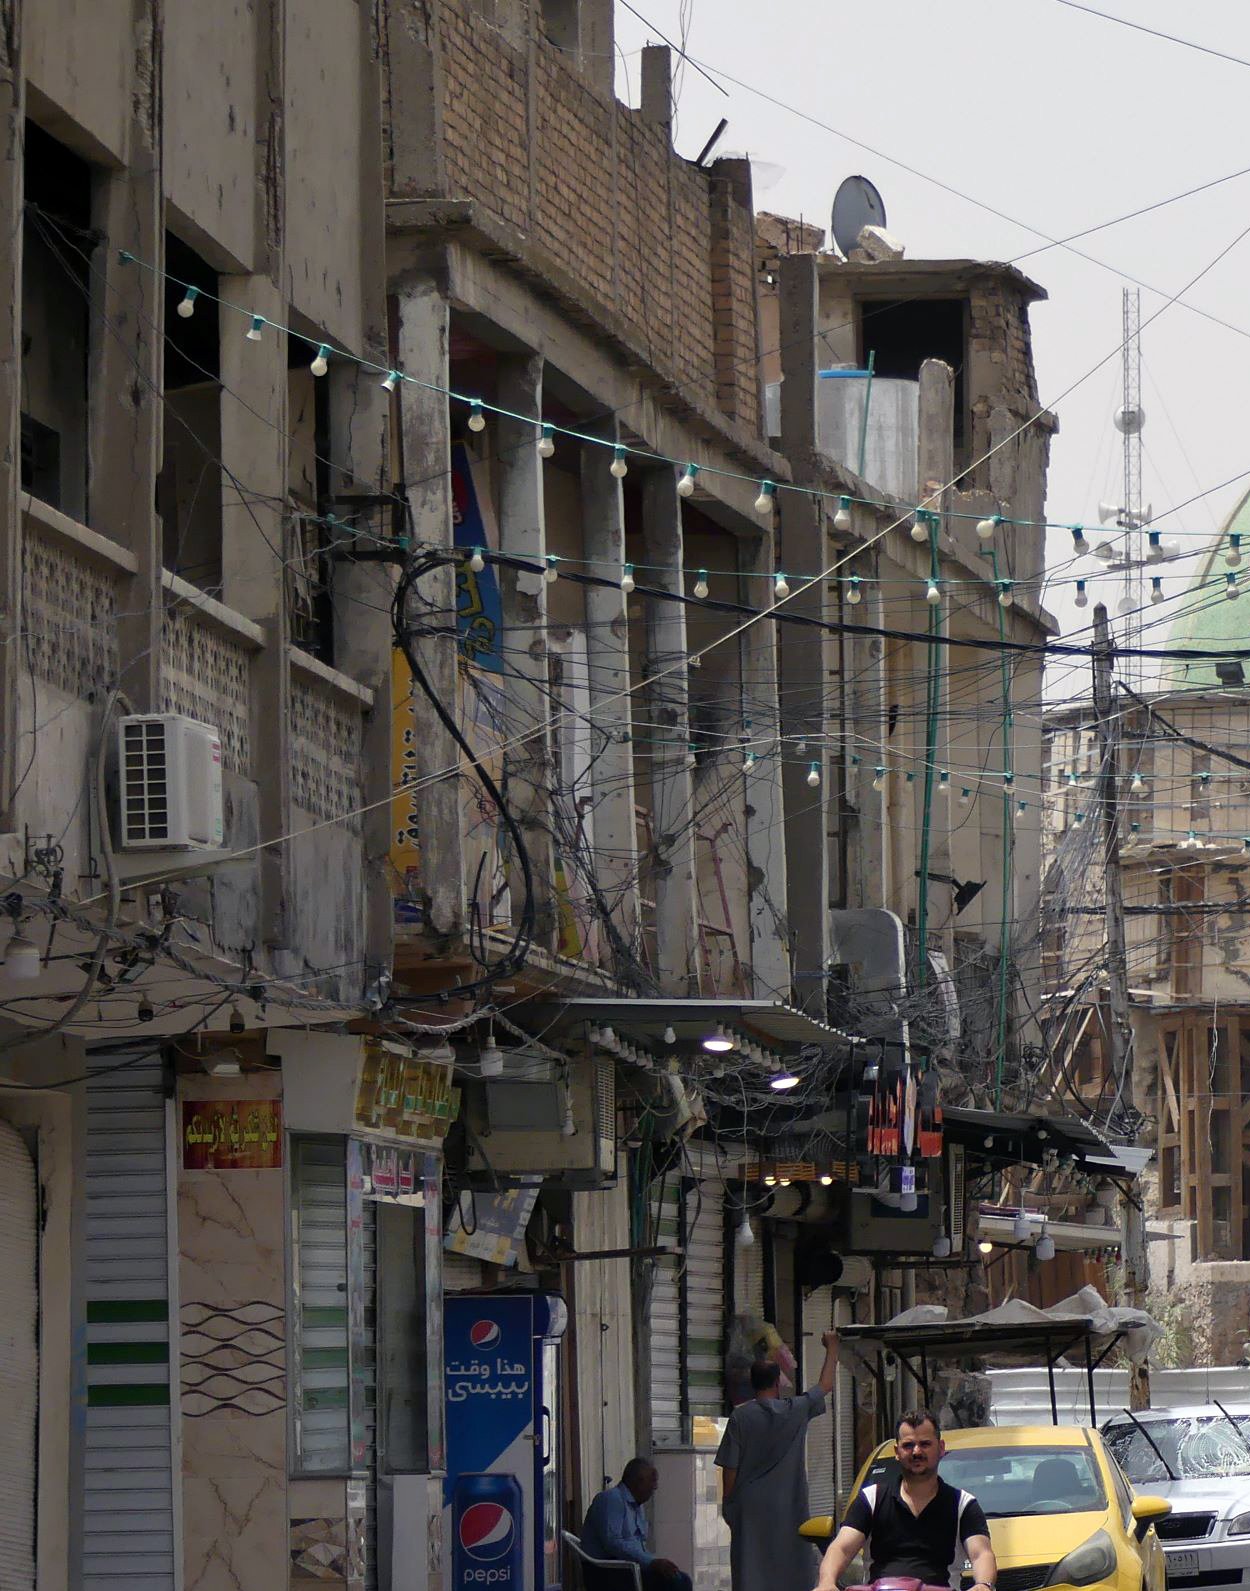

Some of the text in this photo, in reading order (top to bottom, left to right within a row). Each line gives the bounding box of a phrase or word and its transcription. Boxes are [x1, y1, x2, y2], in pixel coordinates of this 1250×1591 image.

[446, 1358, 526, 1378] هذا وقت
[463, 1565, 511, 1585] pepsi
